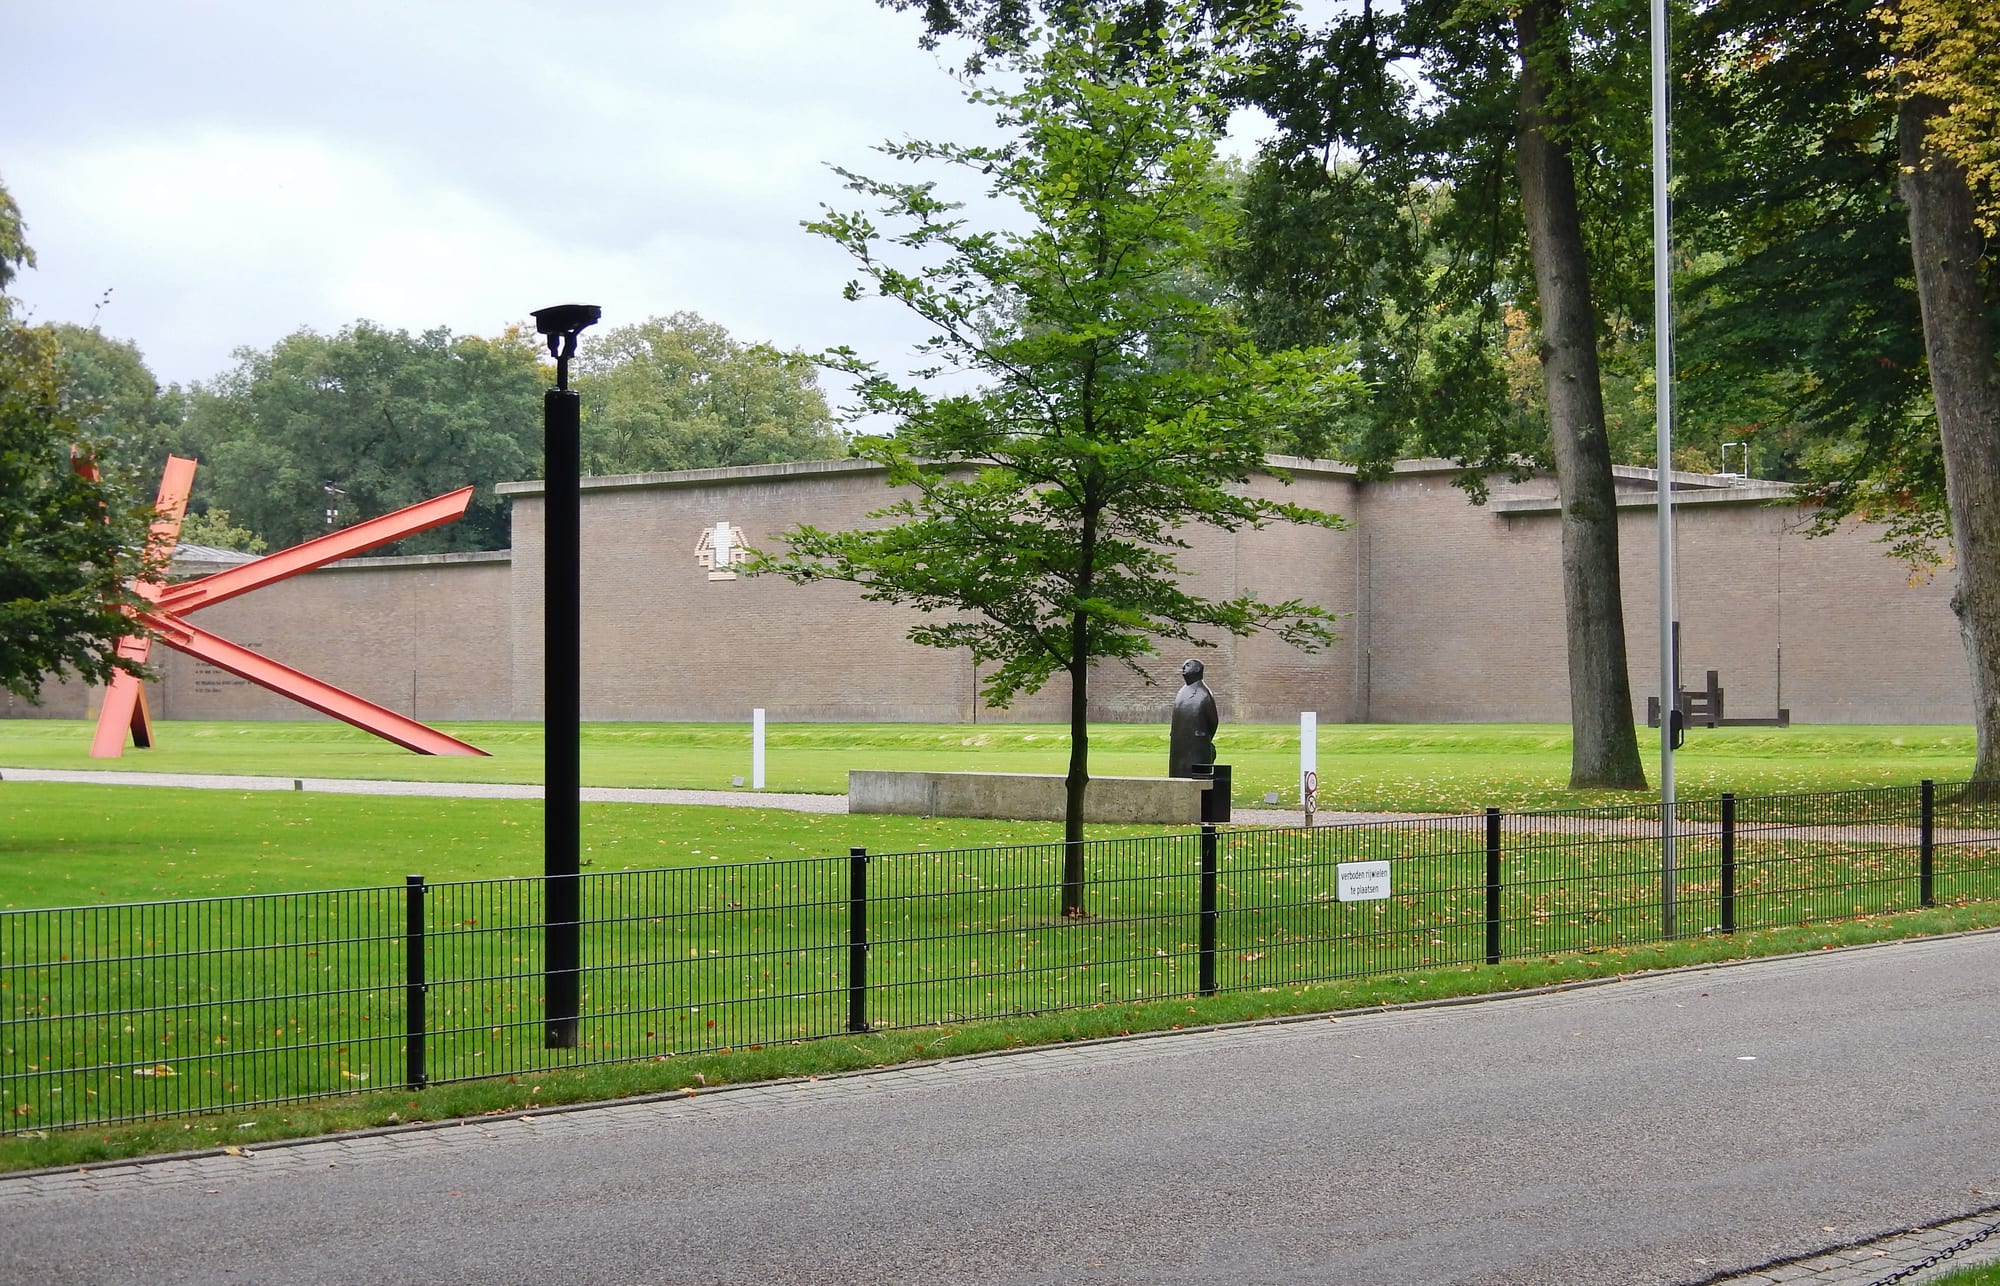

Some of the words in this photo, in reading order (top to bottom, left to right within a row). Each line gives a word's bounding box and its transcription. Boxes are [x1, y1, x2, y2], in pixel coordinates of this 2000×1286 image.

[1341, 870, 1365, 880] verboden
[1350, 886, 1356, 895] te
[1357, 885, 1379, 896] plaatsen
